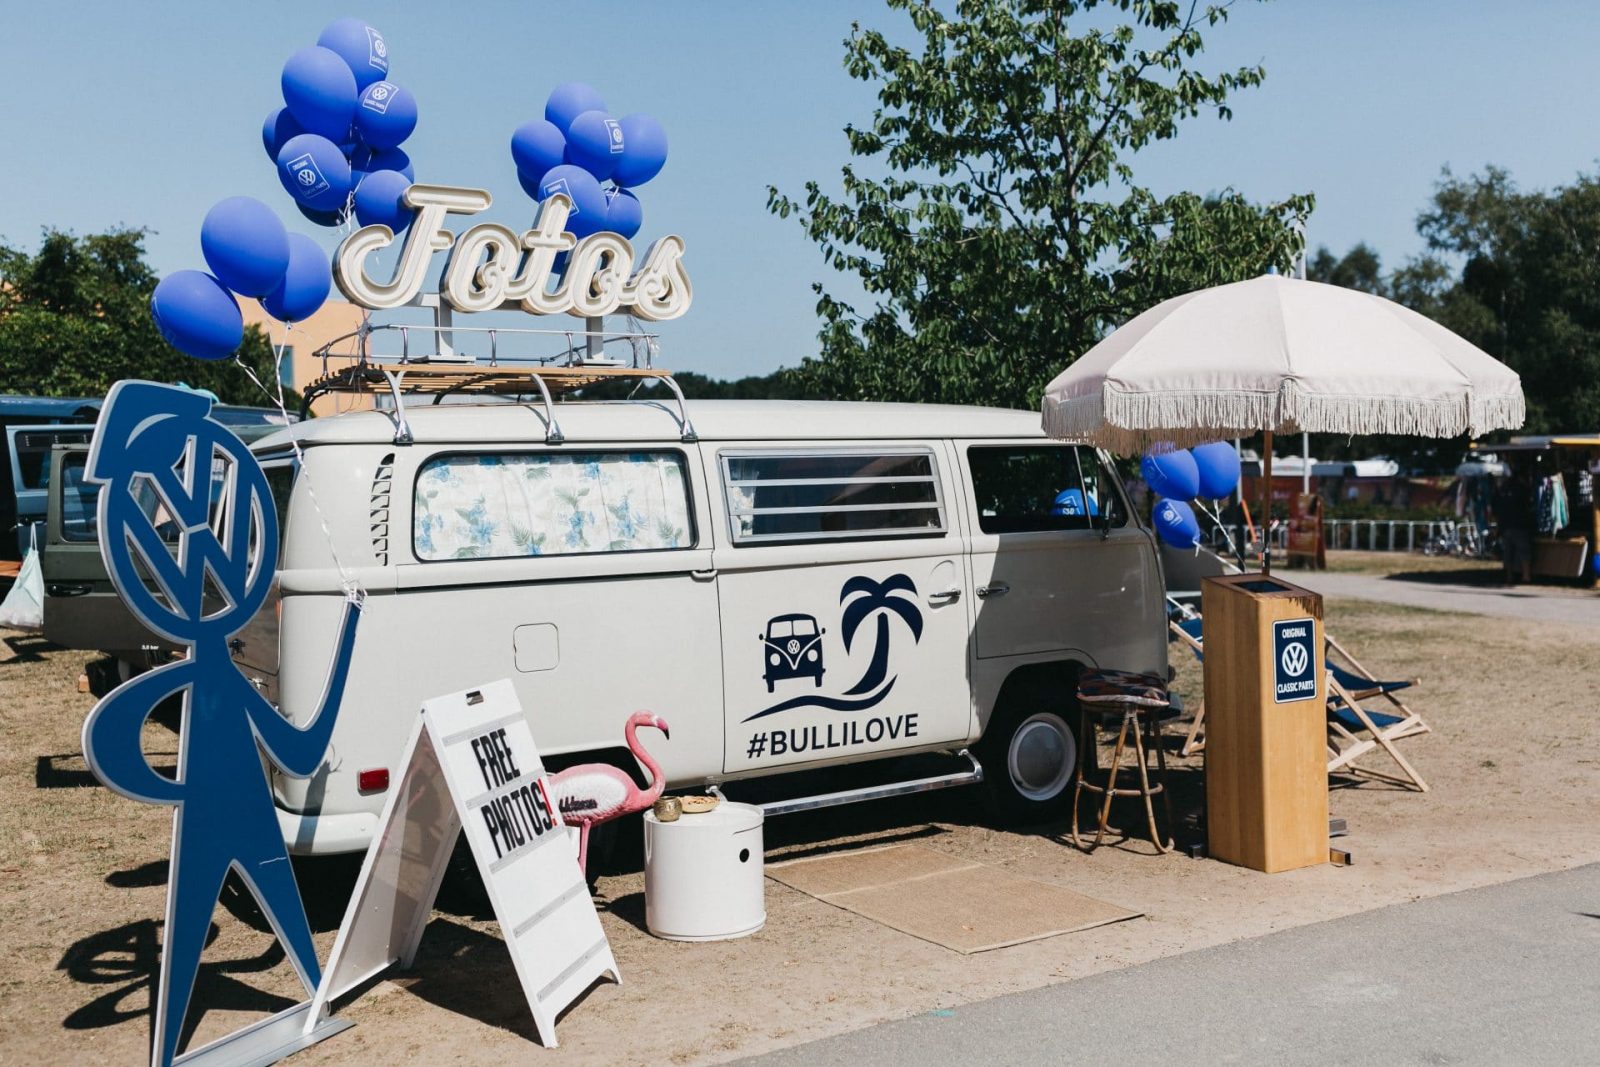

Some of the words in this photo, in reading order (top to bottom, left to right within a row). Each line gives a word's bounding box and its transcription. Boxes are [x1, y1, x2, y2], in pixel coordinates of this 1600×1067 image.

[298, 169, 316, 186] VW
[332, 184, 693, 321] Fotos
[1282, 627, 1306, 638] ORIGINAL
[1282, 642, 1308, 677] VW
[1277, 682, 1298, 694] CLASSIC
[1299, 680, 1314, 691] PARTS
[747, 713, 919, 758] #BULLILOVE
[471, 728, 520, 790] FREE
[481, 778, 558, 858] PHOTOS!
